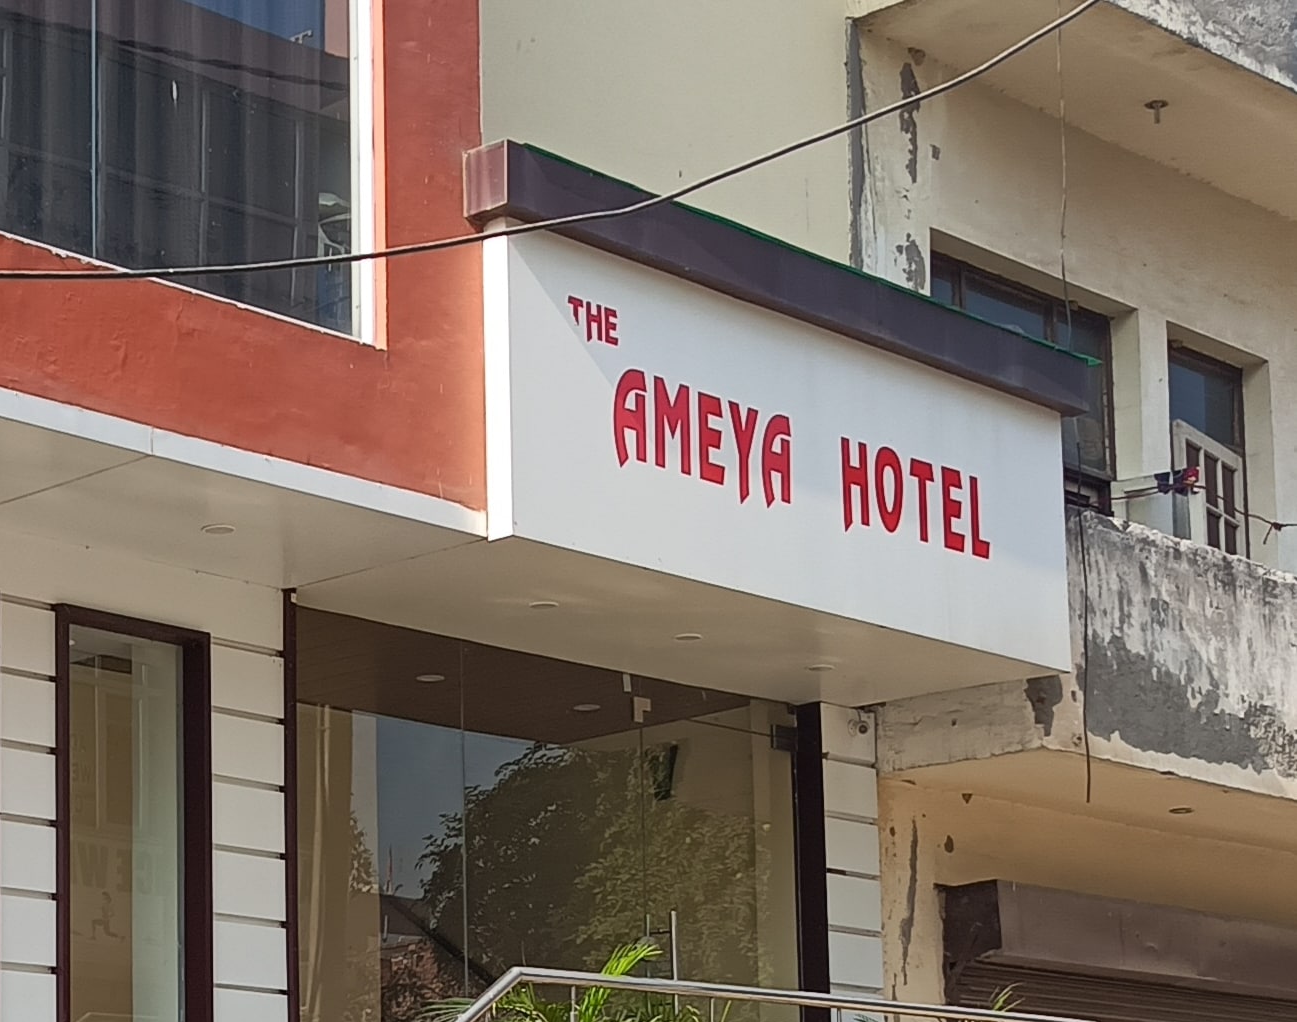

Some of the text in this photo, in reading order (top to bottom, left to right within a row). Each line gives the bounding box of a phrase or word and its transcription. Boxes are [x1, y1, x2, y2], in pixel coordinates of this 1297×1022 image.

[567, 294, 620, 346] THE
[613, 368, 991, 560] AMEYA HOTEL
